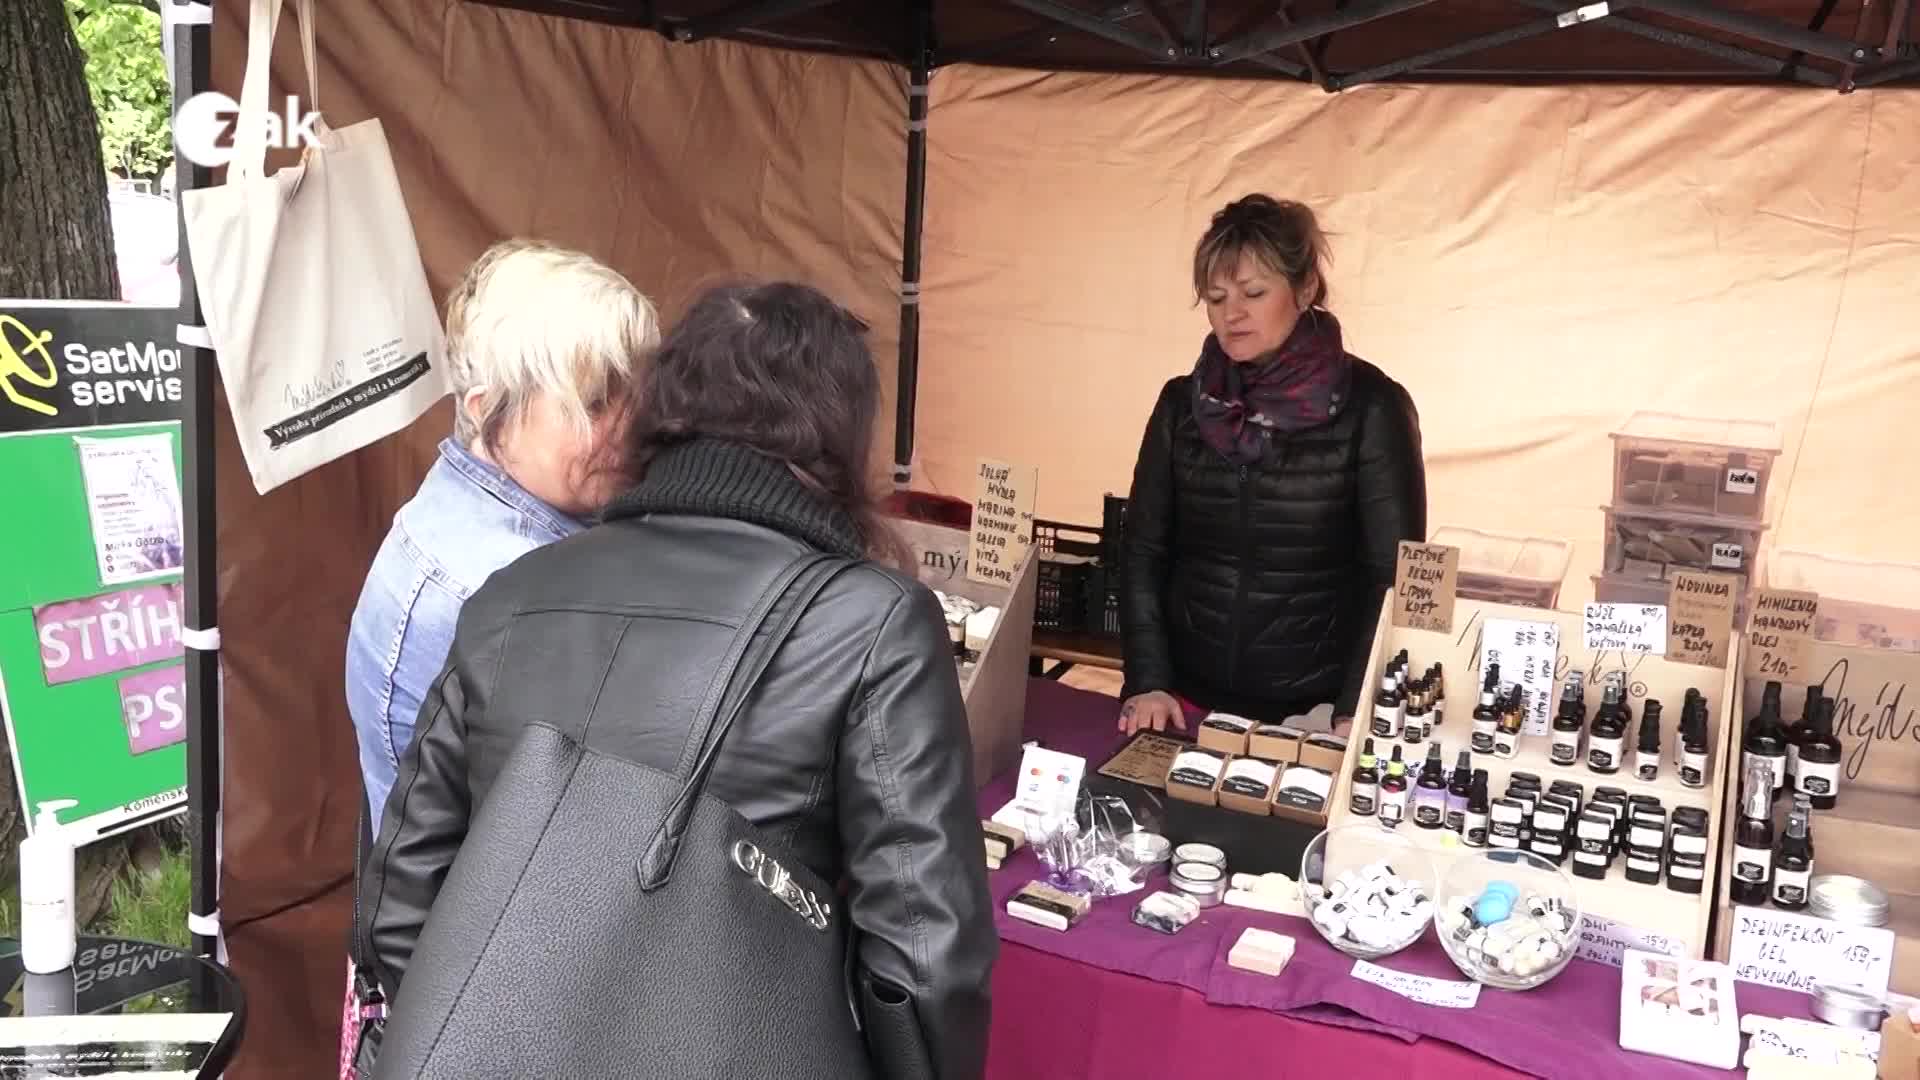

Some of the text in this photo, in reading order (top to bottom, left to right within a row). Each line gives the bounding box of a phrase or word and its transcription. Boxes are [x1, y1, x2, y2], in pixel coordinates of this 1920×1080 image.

[71, 377, 181, 407] servis
[40, 595, 182, 669] STŘÍH
[1752, 631, 1779, 648] OLEJ
[1760, 652, 1799, 677] 210,-
[125, 683, 186, 739] PS
[731, 840, 830, 930] GUESS
